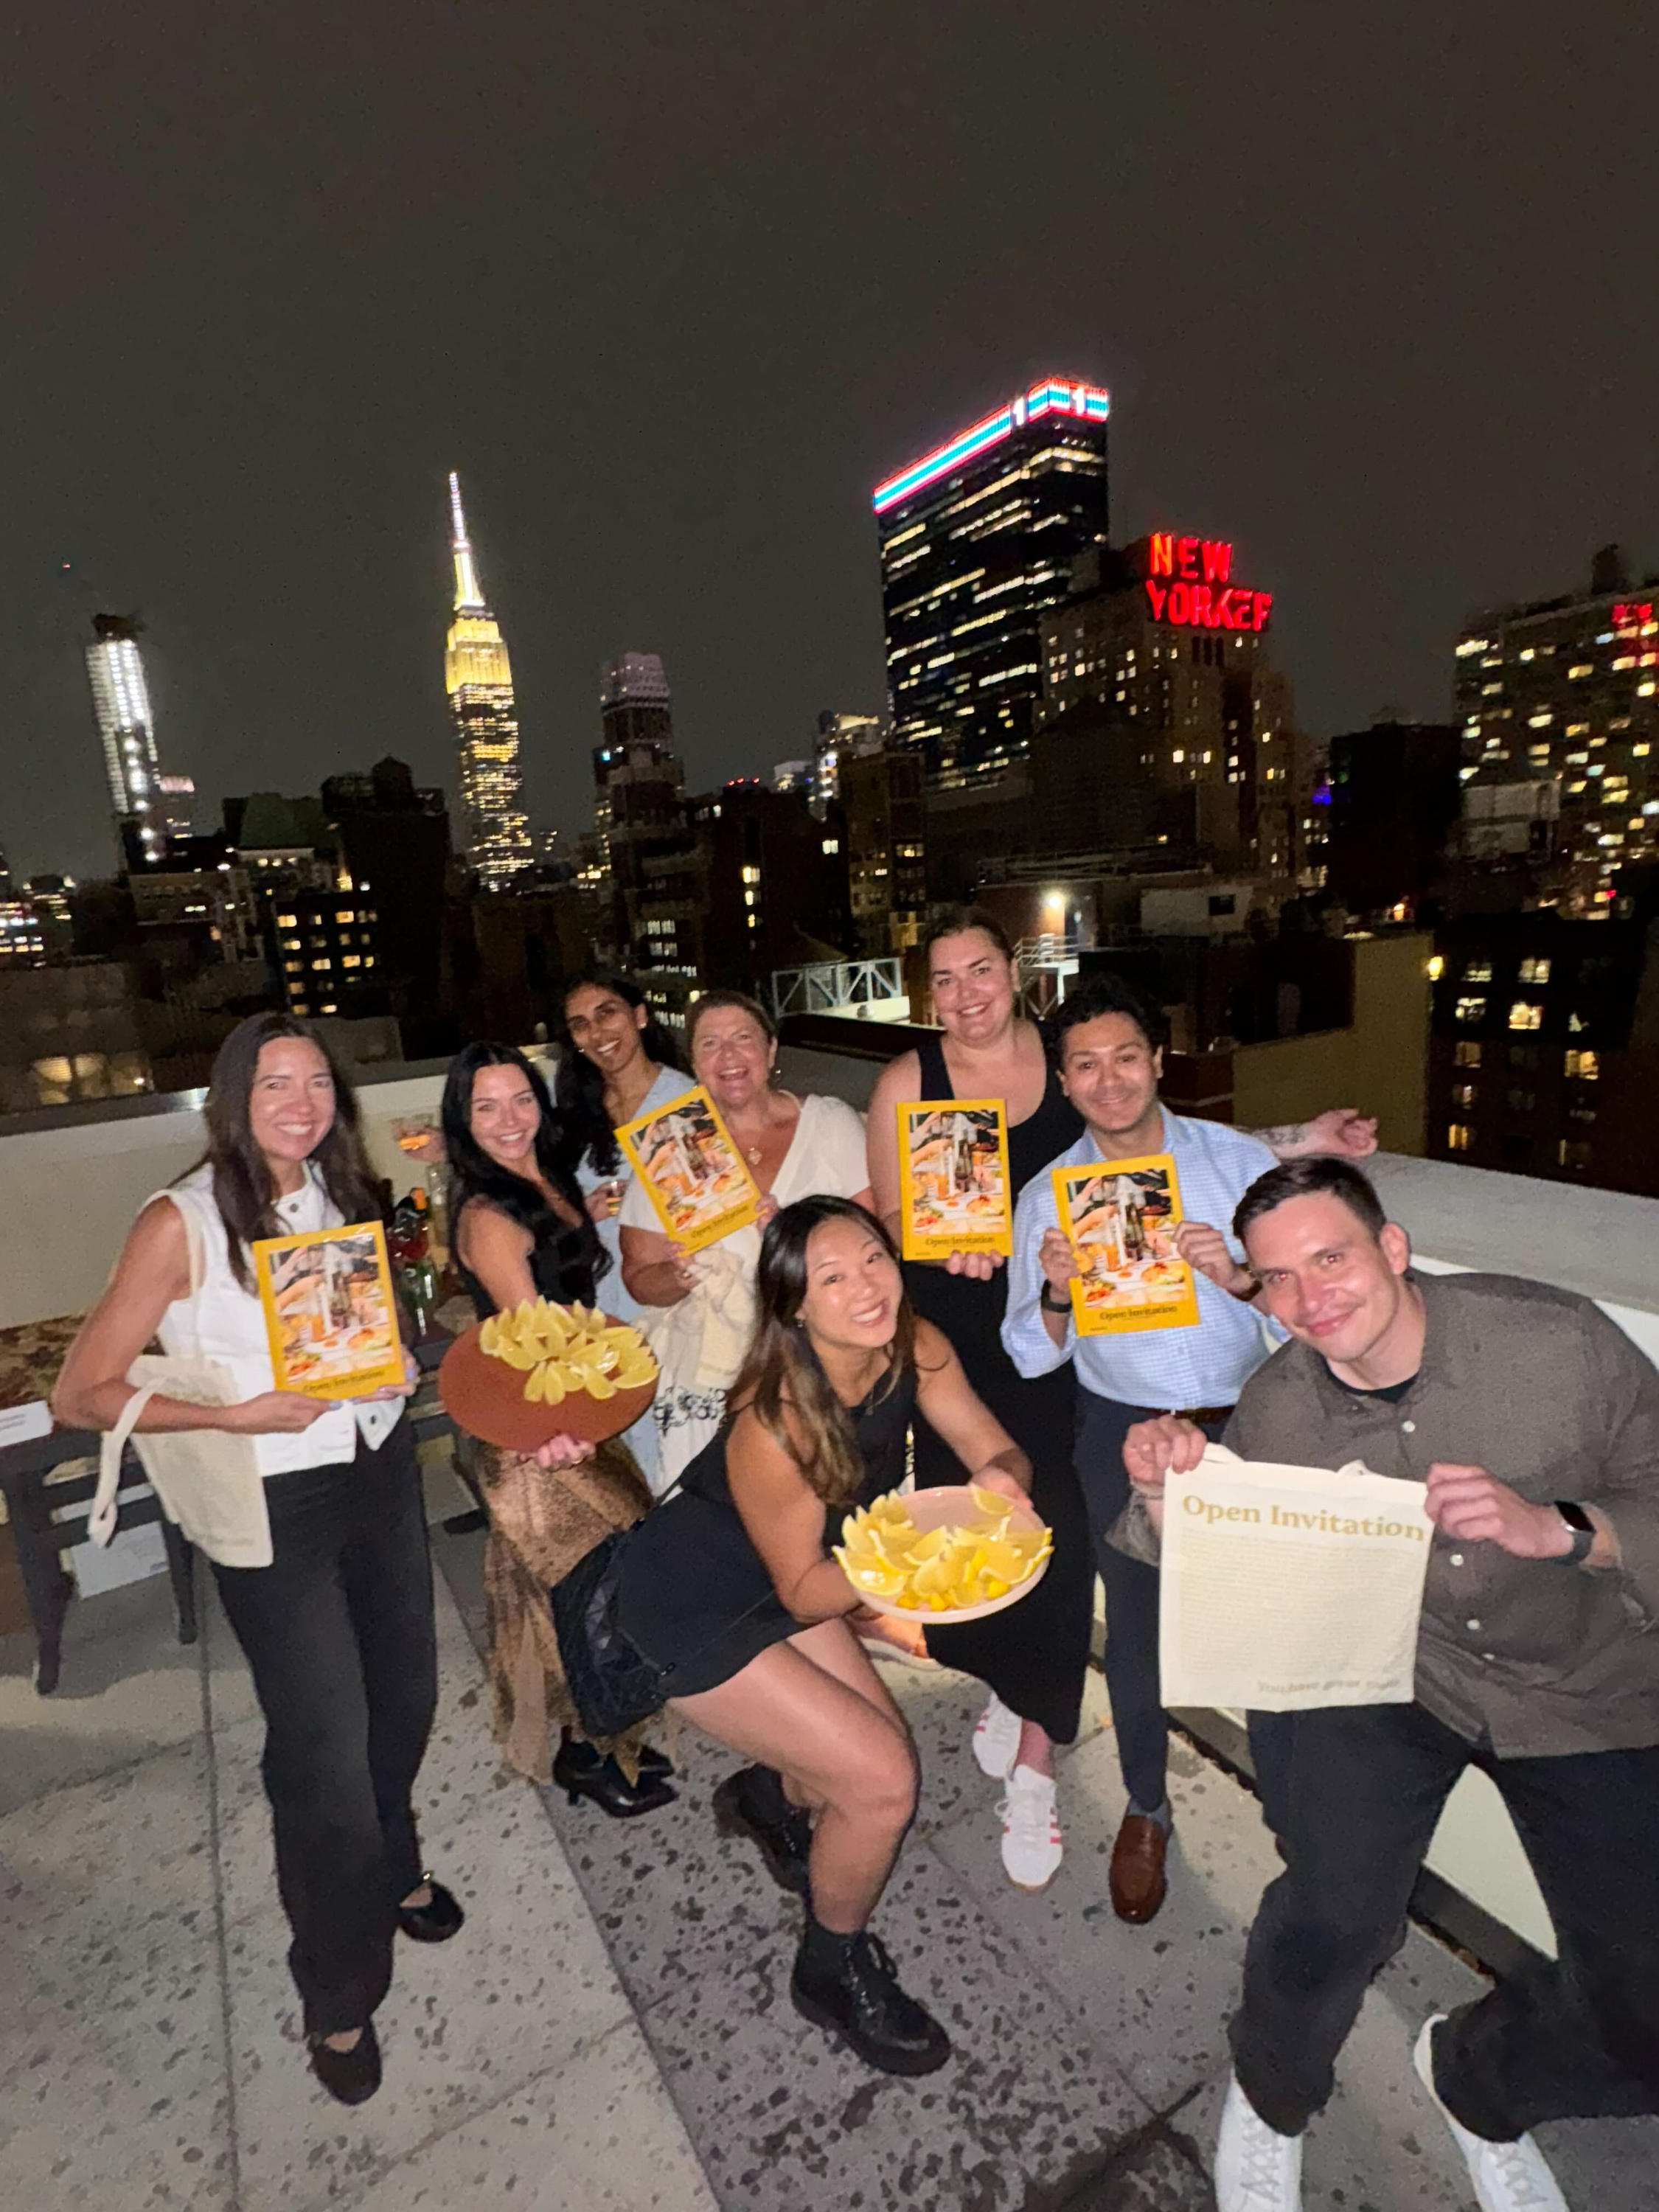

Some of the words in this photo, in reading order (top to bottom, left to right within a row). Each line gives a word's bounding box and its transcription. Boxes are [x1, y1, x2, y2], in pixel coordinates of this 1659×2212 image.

[1150, 532, 1232, 582] NEW
[1183, 1495, 1261, 1524] Open
[1270, 1505, 1425, 1541] Invitation
